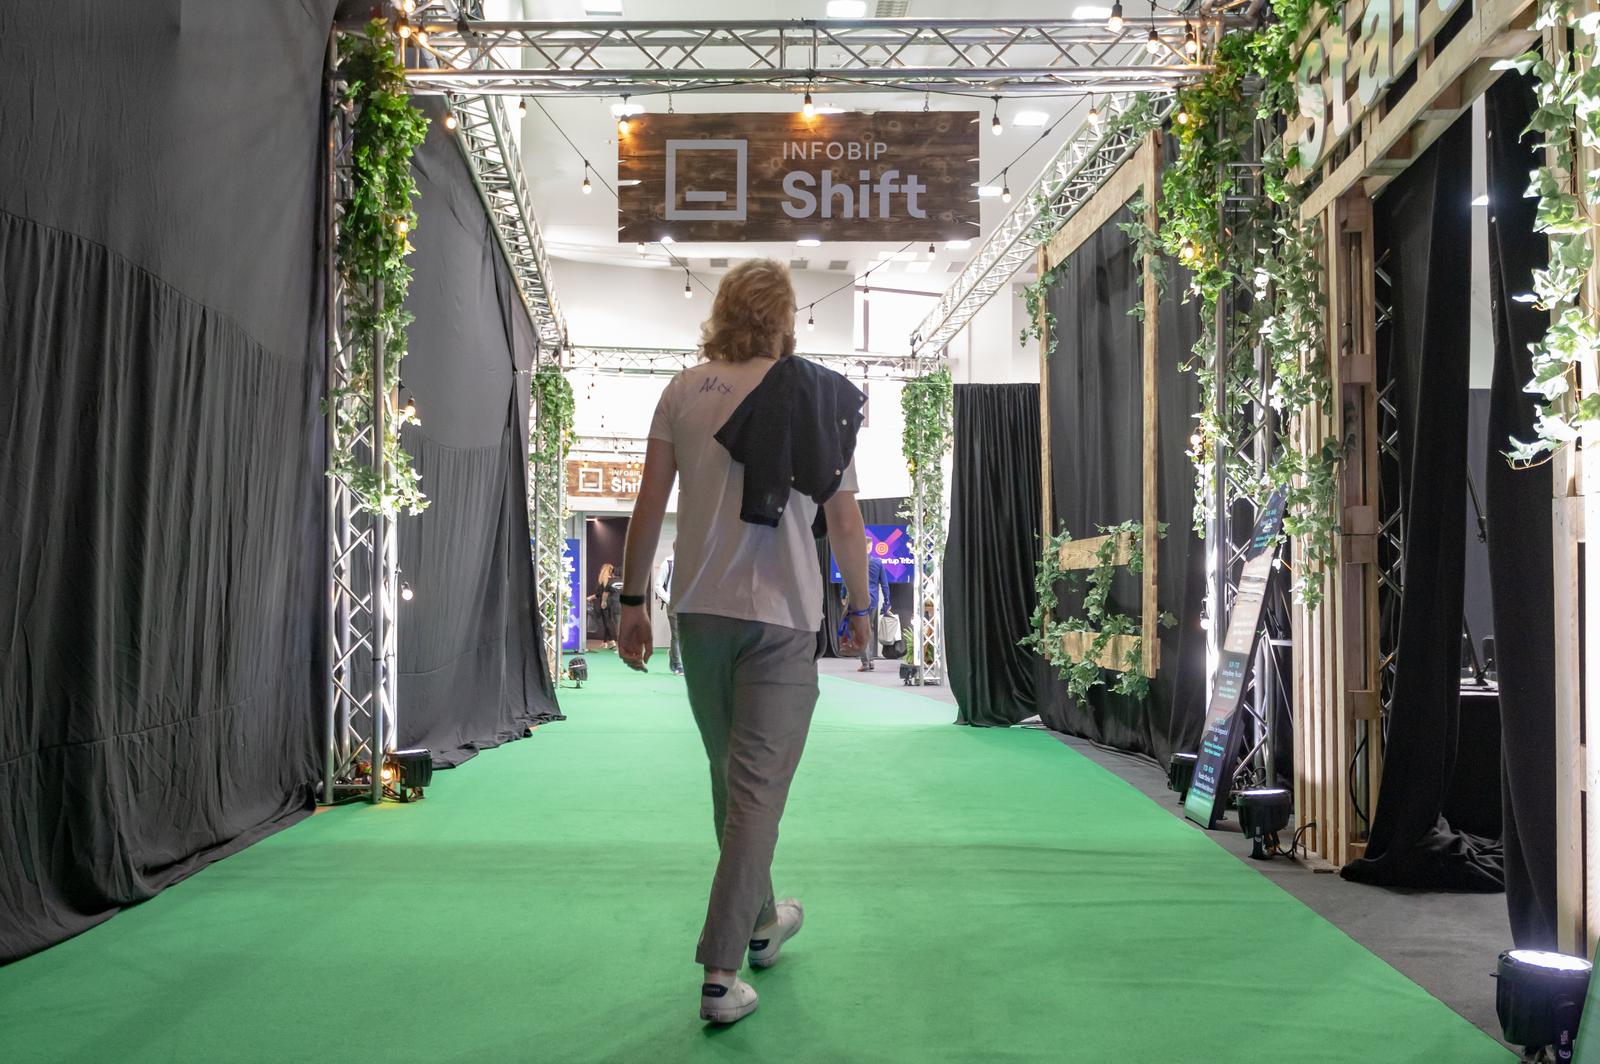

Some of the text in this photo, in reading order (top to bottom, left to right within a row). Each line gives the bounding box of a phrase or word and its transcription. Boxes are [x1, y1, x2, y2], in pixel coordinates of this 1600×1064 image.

[782, 141, 888, 160] INFOBIP
[781, 169, 927, 219] Shift
[611, 477, 642, 493] Shif
